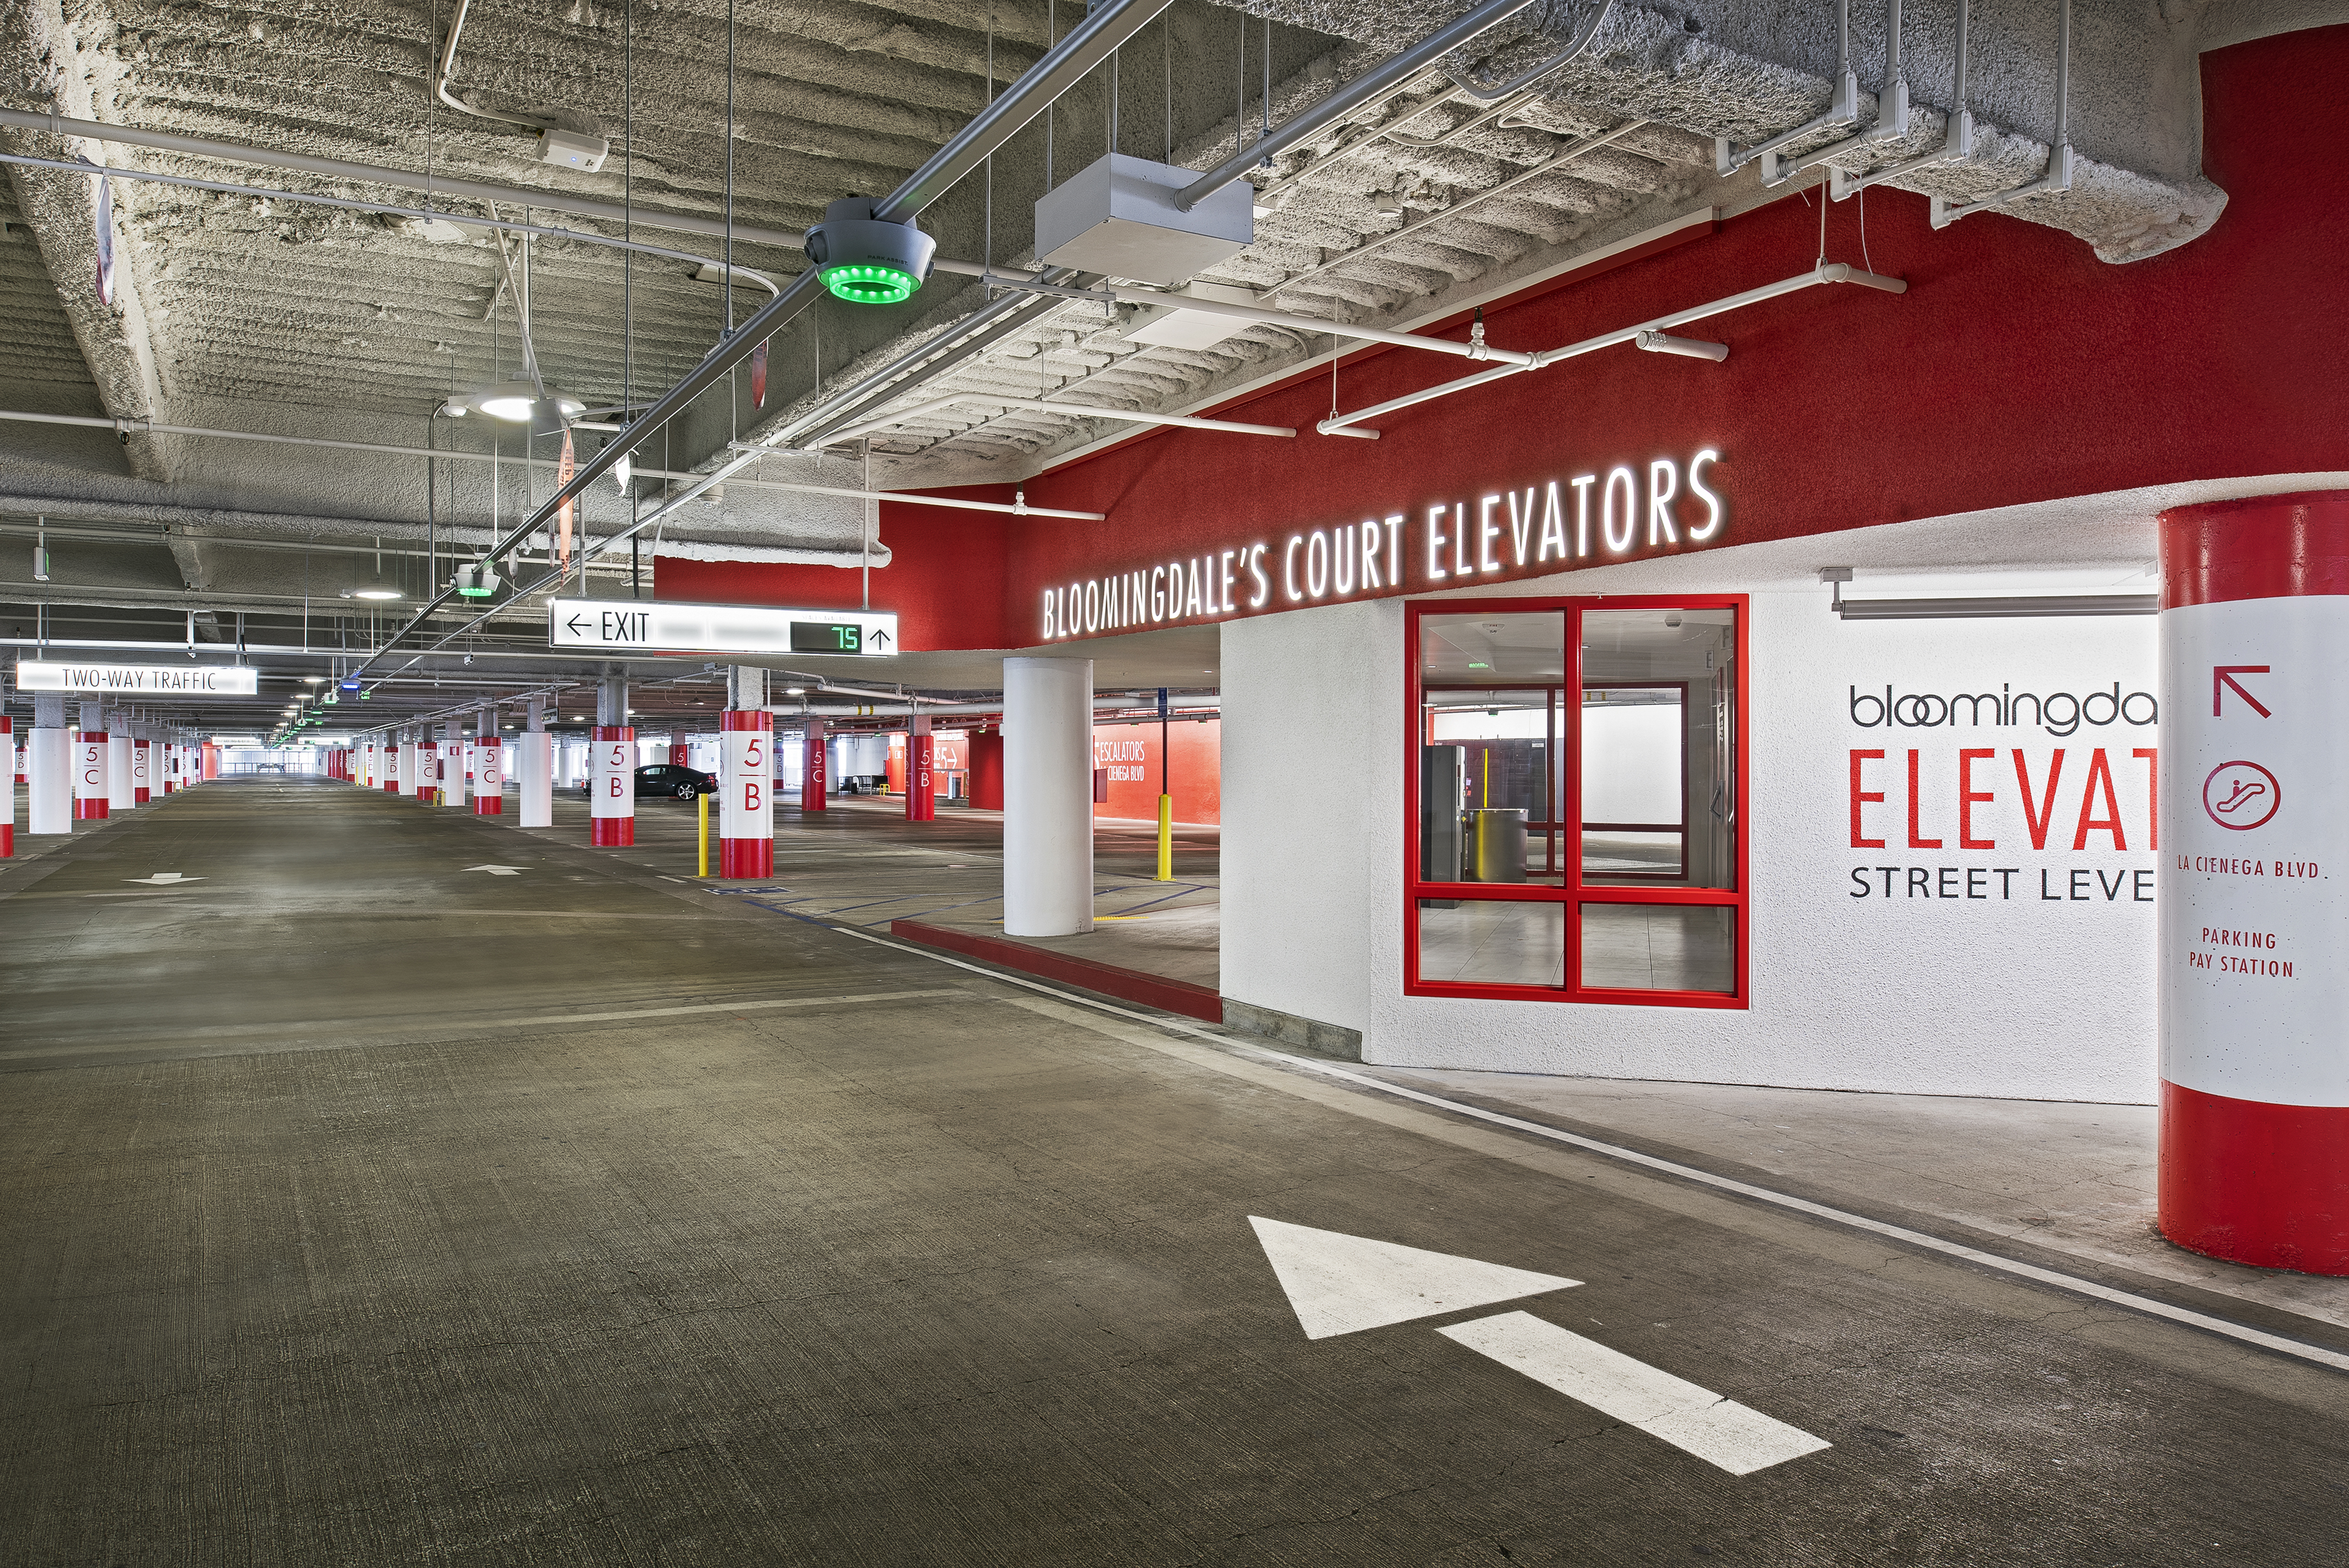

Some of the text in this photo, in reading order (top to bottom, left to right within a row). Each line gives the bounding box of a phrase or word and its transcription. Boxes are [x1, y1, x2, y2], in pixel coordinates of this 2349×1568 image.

[1043, 449, 1720, 640] BLOOMINGDALE'S COURT ELEVATORS
[602, 612, 650, 642] EXIT
[831, 627, 858, 649] 75
[1722, 627, 1730, 647] F
[1706, 652, 1712, 669] E
[62, 668, 216, 690] TWO-WAY TRAFFIC
[86, 747, 98, 762] 5
[135, 751, 144, 761] 5
[390, 753, 397, 762] 5
[425, 752, 433, 762] 5
[485, 749, 495, 763] 5
[610, 745, 625, 766] 5
[677, 753, 684, 762] 5
[744, 739, 763, 767] 5
[813, 751, 822, 764] 5
[920, 750, 930, 765] 5
[1100, 740, 1145, 762] ESCALATORS
[85, 770, 99, 785] C
[135, 766, 144, 777] C
[423, 767, 433, 777] C
[484, 770, 496, 783] C
[813, 770, 823, 783] C
[921, 772, 930, 787] B
[1108, 765, 1144, 781] CIENEGA BLVD
[610, 777, 624, 798] B
[745, 783, 761, 811] B
[2178, 854, 2190, 871] LA
[2195, 857, 2264, 876] CIENEGA
[1850, 867, 2154, 902] STREET LEVE
[2203, 927, 2276, 950] PARKING
[2190, 951, 2293, 978] PAY STATION
